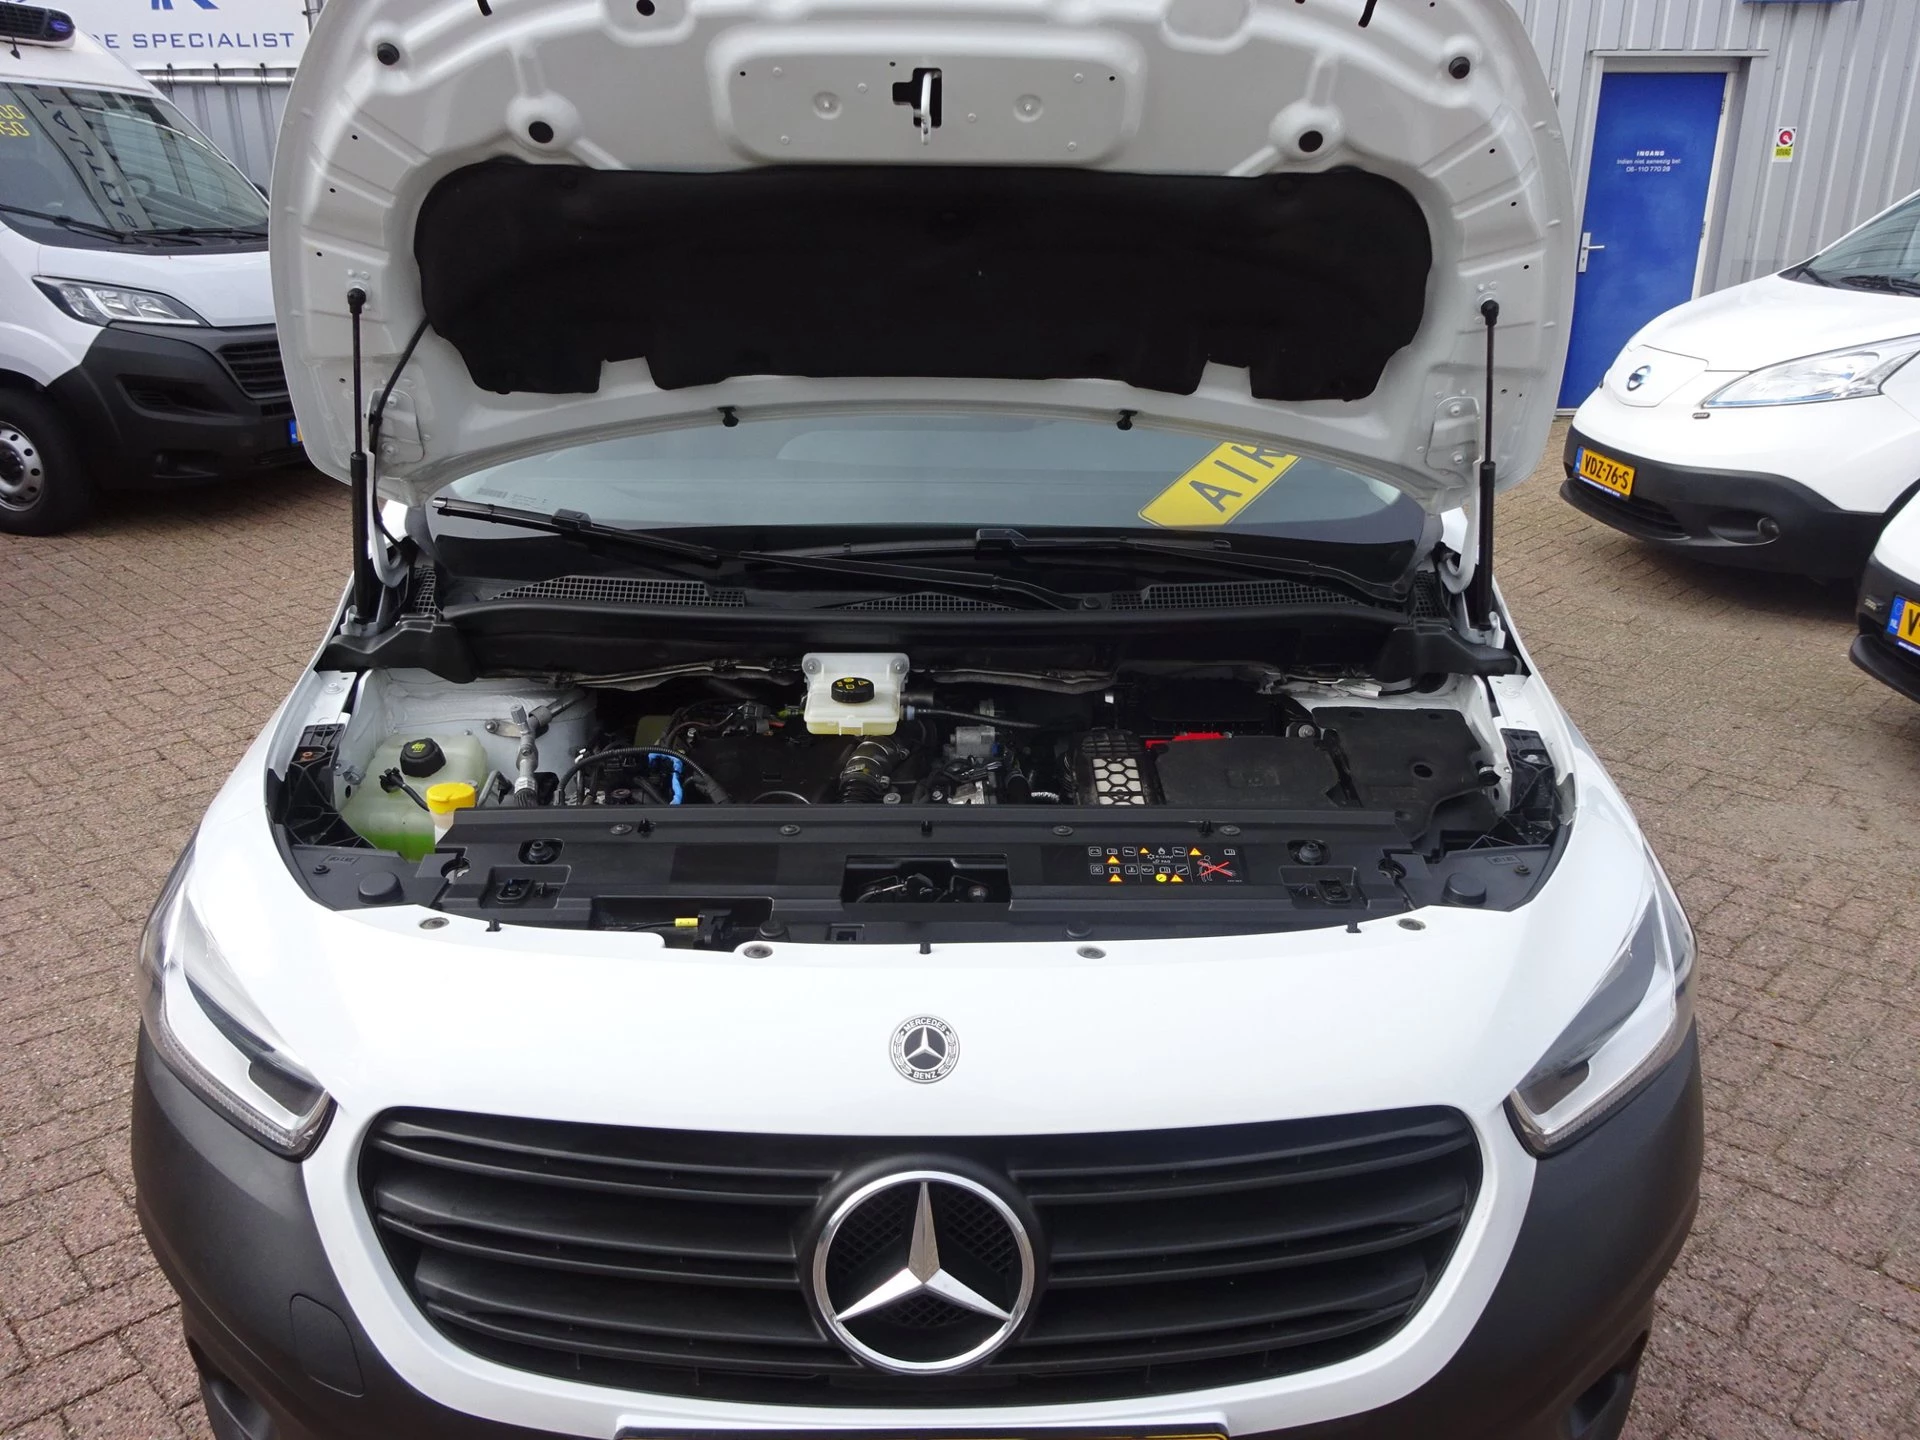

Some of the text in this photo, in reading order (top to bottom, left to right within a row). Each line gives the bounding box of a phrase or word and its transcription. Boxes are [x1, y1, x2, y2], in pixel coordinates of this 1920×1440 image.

[132, 33, 294, 48] SPECIALIST
[1189, 445, 1288, 513] AIR
[1584, 453, 1630, 490] VDZ-76-S
[903, 1018, 947, 1032] MERCEDES
[913, 1071, 938, 1080] BENZ
